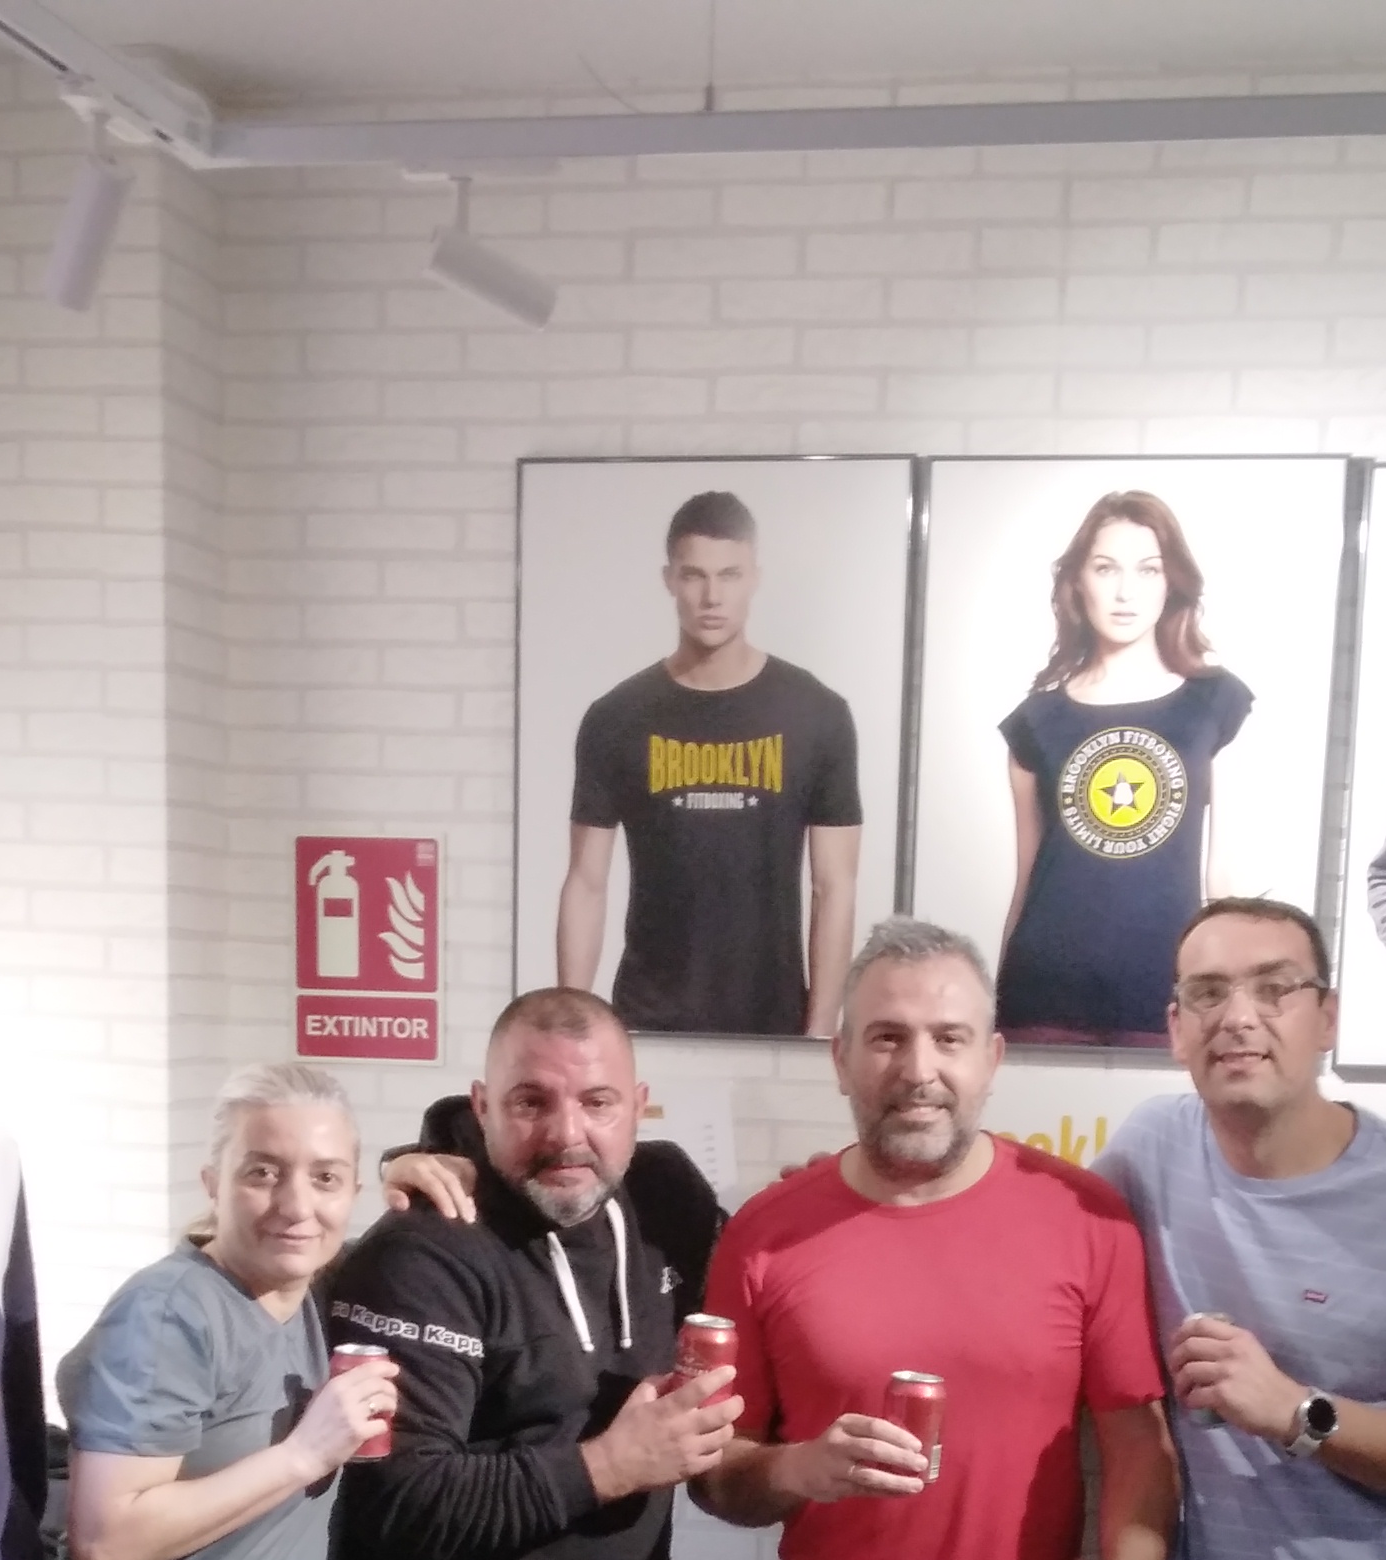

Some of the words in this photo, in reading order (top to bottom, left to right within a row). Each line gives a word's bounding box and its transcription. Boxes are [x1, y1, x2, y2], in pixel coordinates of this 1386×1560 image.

[649, 733, 784, 794] BROOKLYN
[1062, 731, 1121, 794] BROOKLYN
[1123, 731, 1183, 791] FITBOXING
[1064, 806, 1100, 849] LIMITS
[1148, 803, 1183, 842] FIGHT
[1103, 838, 1148, 854] YOUR
[305, 1014, 430, 1039] EXTINTOR
[350, 1304, 419, 1340] Kappa
